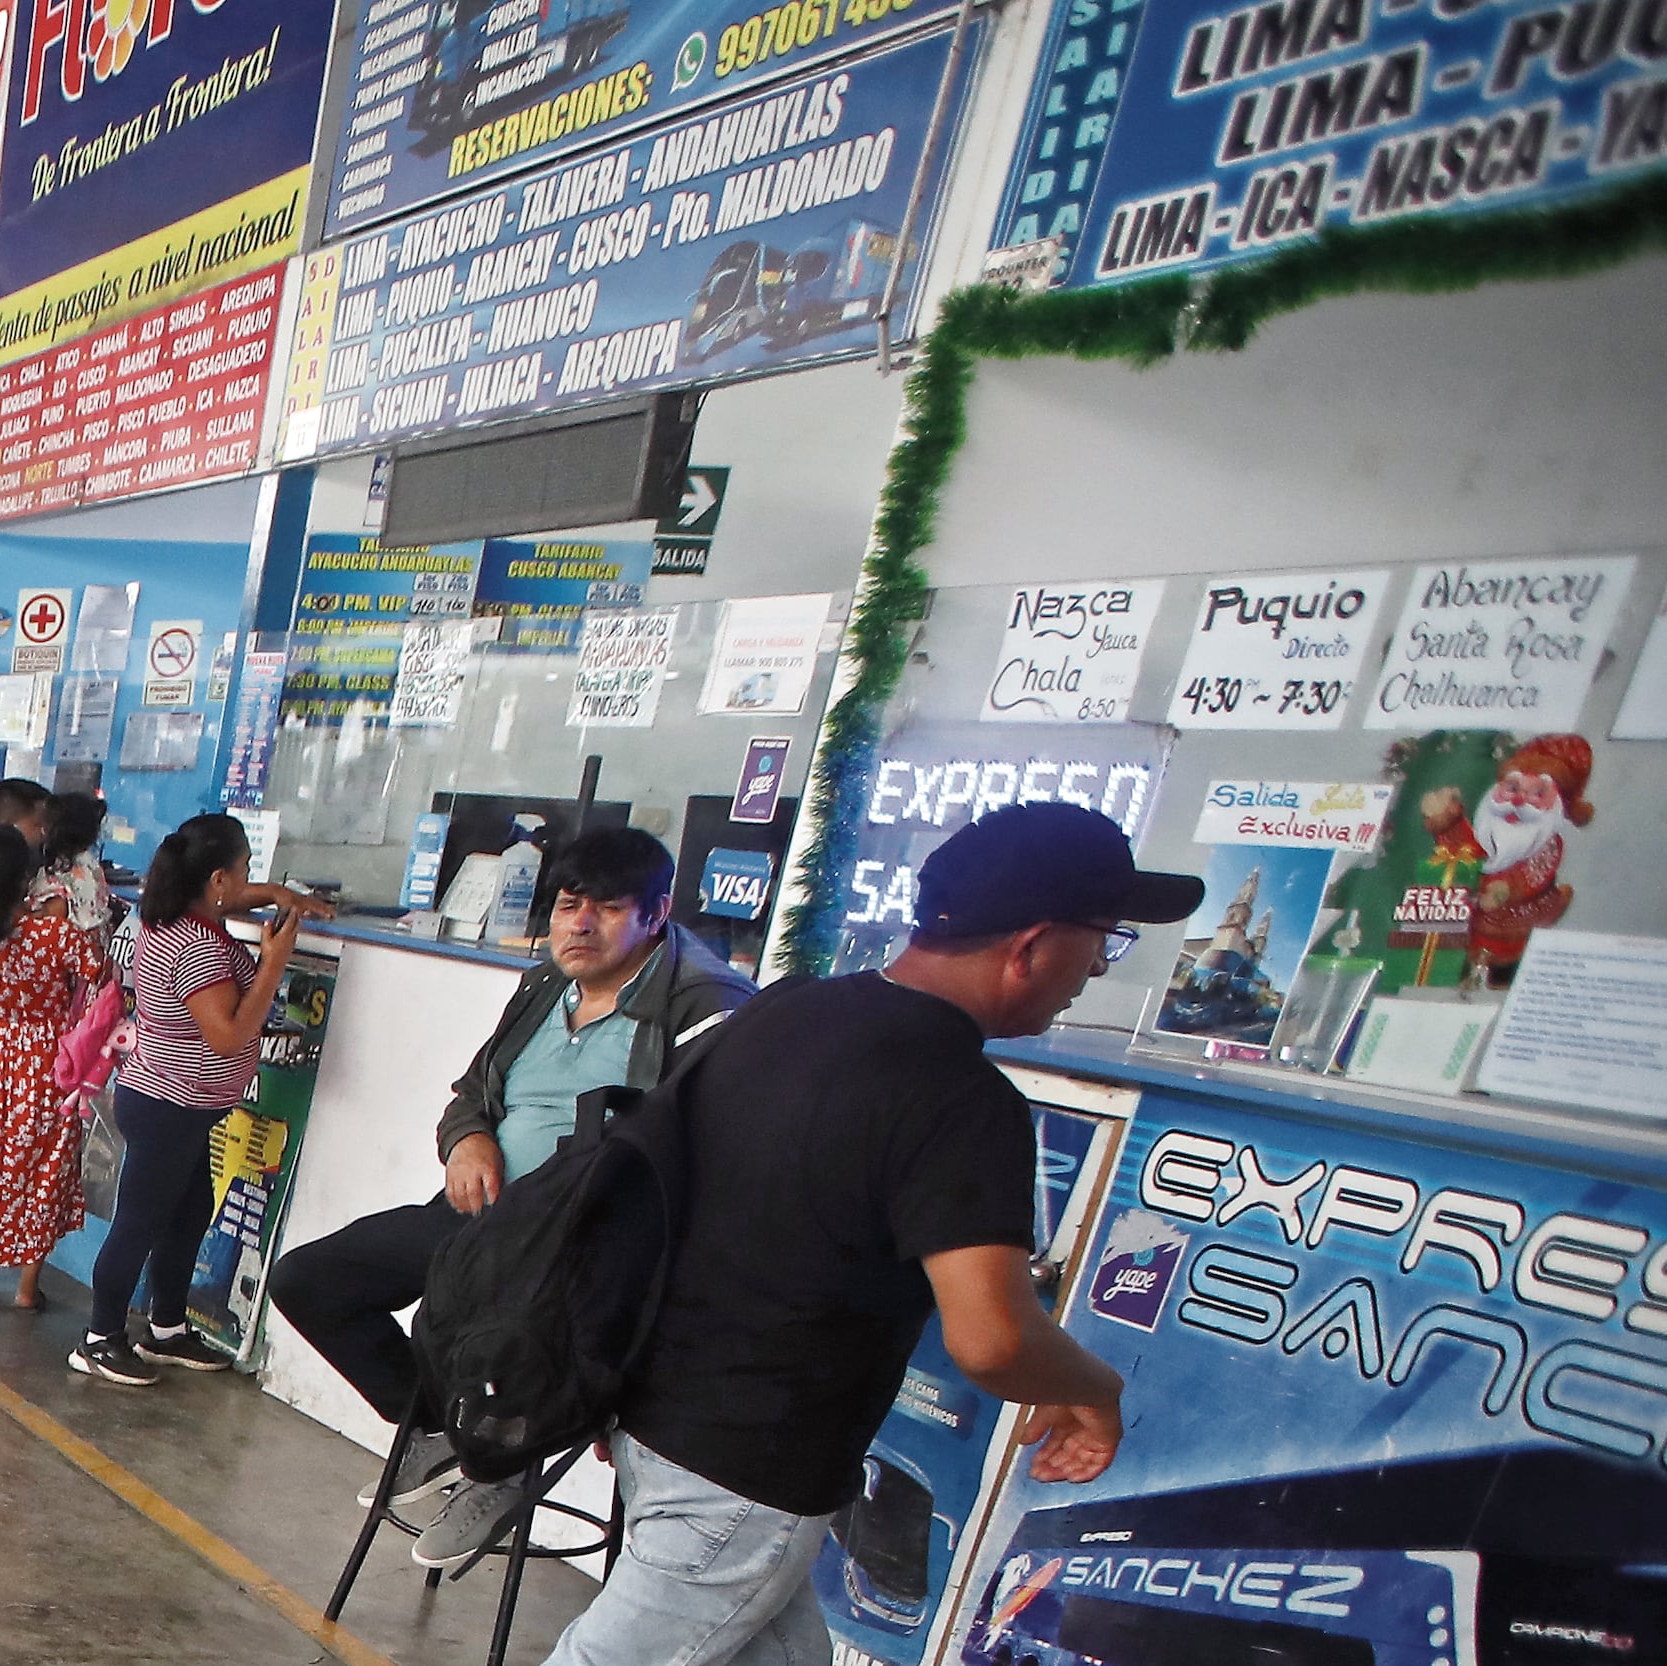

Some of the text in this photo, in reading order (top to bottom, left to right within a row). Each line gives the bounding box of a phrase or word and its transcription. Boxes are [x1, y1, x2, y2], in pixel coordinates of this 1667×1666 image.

[1174, 0, 1369, 97] LIMA
[30, 153, 57, 203] De
[58, 114, 144, 191] Frontera
[141, 104, 162, 143] a
[165, 24, 282, 135] Frontera!
[447, 60, 654, 180] RESERVACIONES:
[1218, 40, 1429, 168] LIMA
[343, 73, 851, 291] LIMA AYACUCHO TALAVERA ANDAHUAYLAS
[1095, 183, 1218, 279] LIMA
[1229, 153, 1336, 251] ICA
[1351, 98, 1564, 225] NASCA
[334, 286, 378, 343] LIMA
[383, 263, 457, 329] PUQUIO
[461, 229, 562, 307] ABANCAY
[567, 201, 654, 277] CUSCO
[713, 124, 897, 236] MALDONADO
[33, 294, 53, 334] de
[52, 271, 123, 343] pasajes
[126, 274, 143, 302] a
[145, 233, 196, 295] nivel
[193, 188, 301, 277] nacional
[20, 360, 45, 384] CHALA
[55, 348, 79, 371] ATICO
[140, 317, 164, 344] ALTO
[169, 300, 206, 334] SIHUAS
[219, 274, 276, 315] AREQUIPA
[52, 306, 271, 399] ILO CUSCO ABANCAY SICUANI PUQUIO
[324, 277, 599, 395] LIMA PUCALLPA HUANUCO
[40, 339, 266, 426] PUNO PUERTO MALDONADO DESAGUADERO
[82, 418, 109, 445] PISCO
[117, 407, 145, 434] PISCO
[147, 395, 185, 425] PUEBLO
[196, 387, 213, 412] ICA
[224, 373, 260, 402] NAZCA
[318, 318, 684, 446] LIMA SICUANI JULIACA AREQUIPA
[159, 425, 191, 453] PIURA
[205, 408, 254, 441] SULLANA
[85, 453, 195, 497] CHIMBOTE CAJAMARCA
[308, 552, 379, 571] AYACUCHO
[507, 561, 557, 579] CUSCO
[343, 595, 409, 612] PM. VIP
[1007, 588, 1134, 640] Nazca
[1201, 580, 1366, 640] Puquio
[1420, 566, 1605, 624] Abancay
[1282, 632, 1350, 660] Directo
[1405, 615, 1587, 680] Santa Rosa
[990, 654, 1083, 713] Chala
[1077, 695, 1117, 721] 8:50
[1182, 676, 1342, 716] 4:30 7:30
[1378, 668, 1541, 714] Chalhuanca
[1207, 781, 1301, 811] Salida
[1237, 811, 1351, 843] Exclusiva
[711, 872, 761, 908] VISA
[1392, 905, 1471, 923] NAVIDAD
[1401, 886, 1469, 907] FELIZ
[1139, 1127, 1667, 1342] EXPRE
[1103, 1266, 1156, 1301] yape
[1061, 1553, 1366, 1619] SANCHEZ
